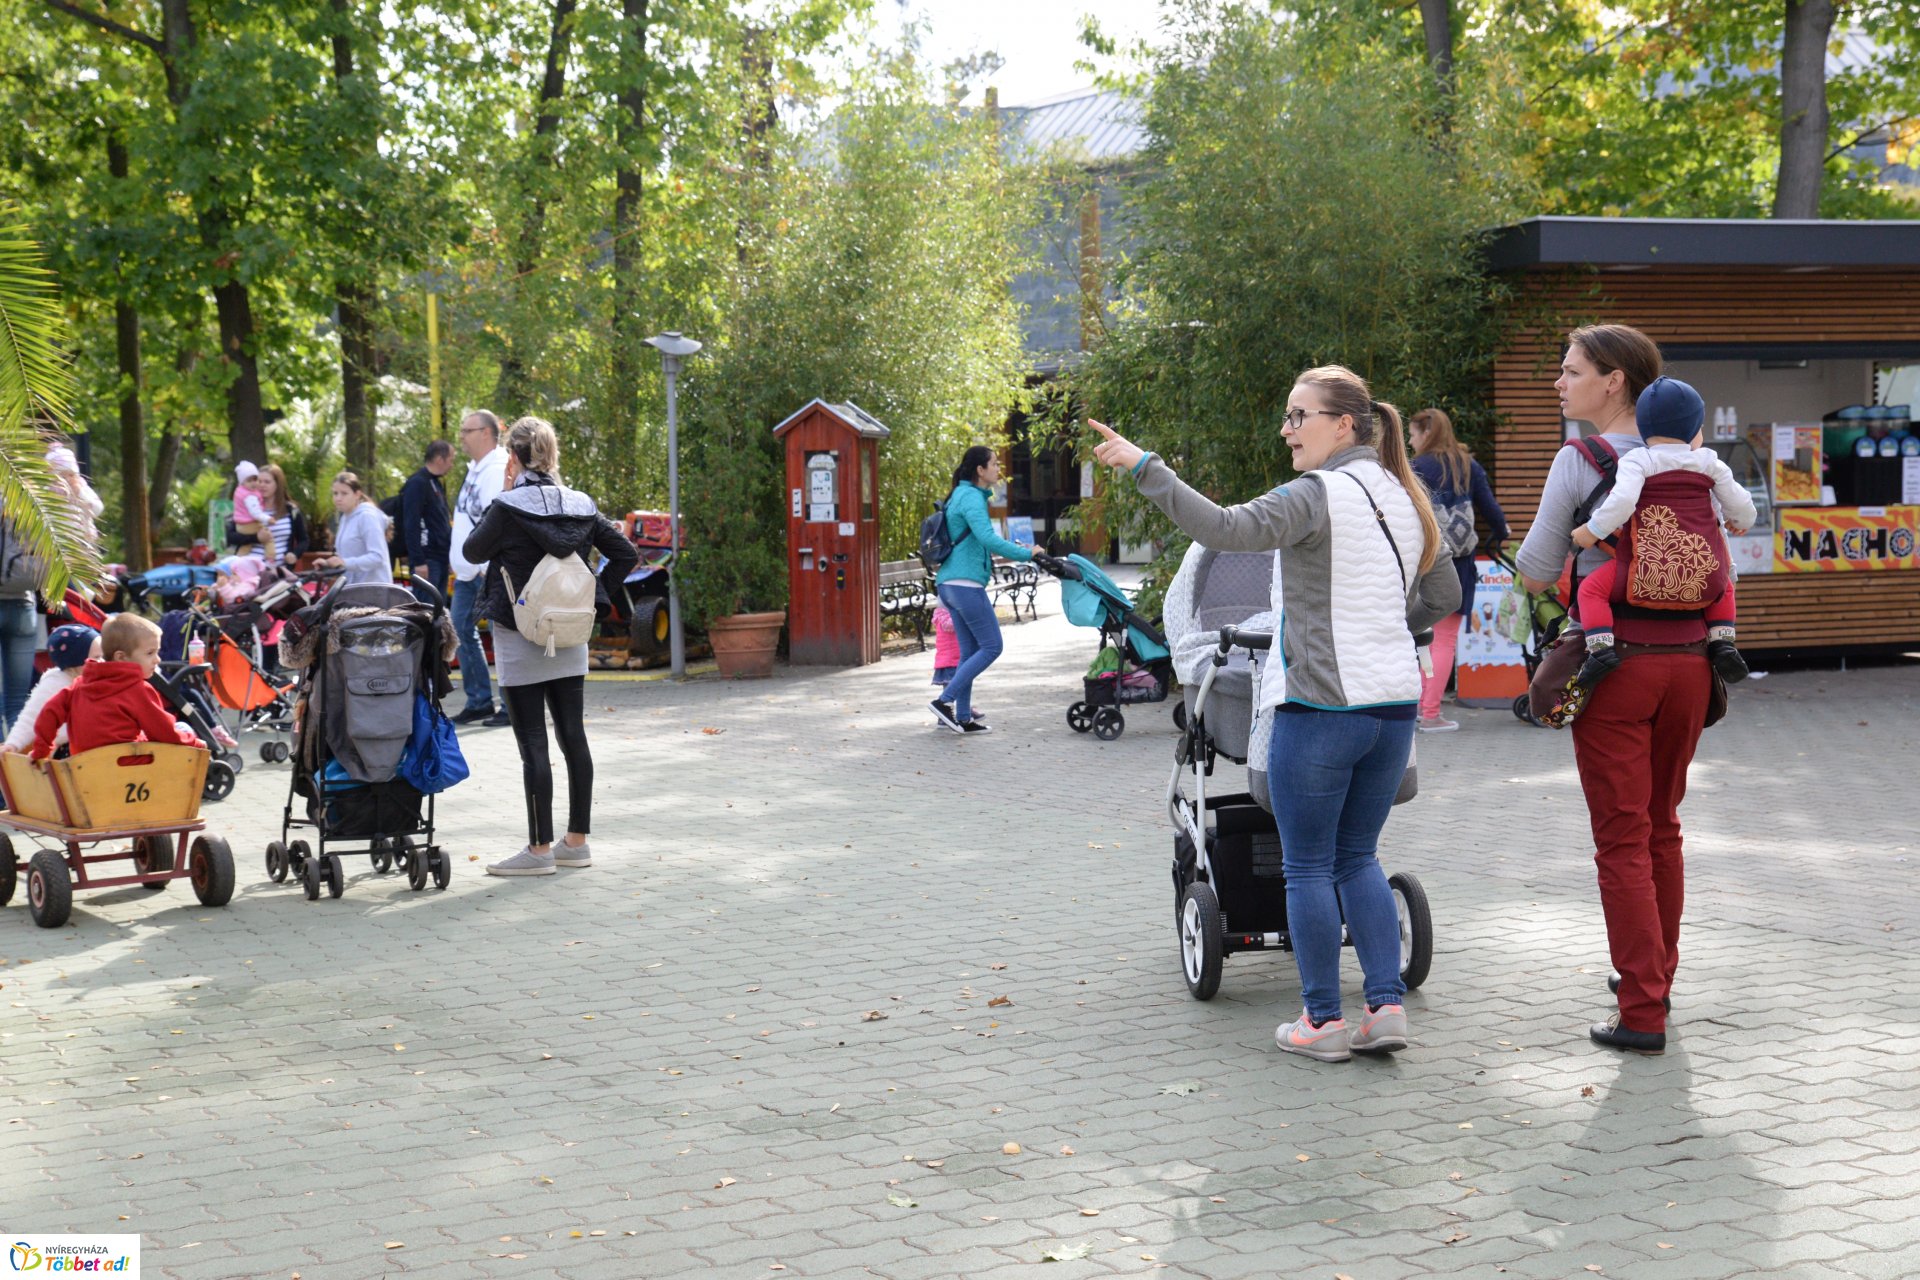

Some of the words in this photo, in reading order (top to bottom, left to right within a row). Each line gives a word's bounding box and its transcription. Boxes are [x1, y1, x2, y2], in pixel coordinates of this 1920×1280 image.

[1784, 527, 1920, 561] NACHO
[1476, 574, 1514, 585] Kinde
[124, 781, 150, 804] 26
